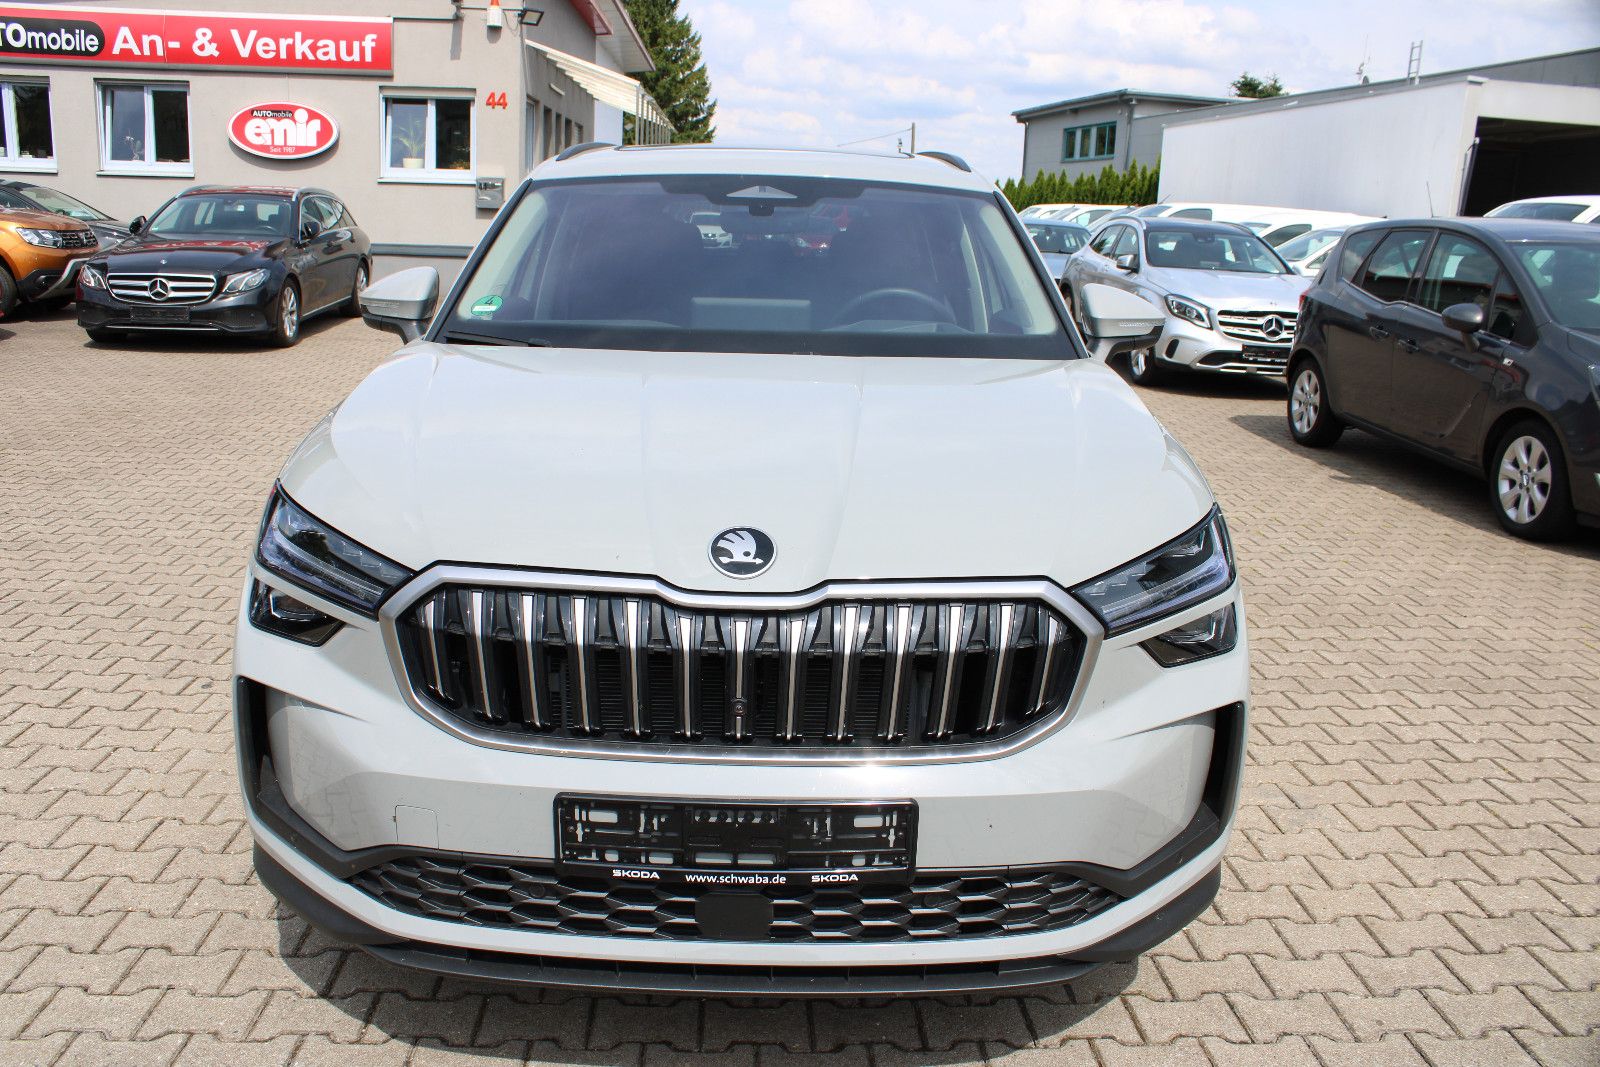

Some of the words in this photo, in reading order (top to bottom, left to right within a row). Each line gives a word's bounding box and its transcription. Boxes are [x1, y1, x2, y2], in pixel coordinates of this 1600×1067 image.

[112, 26, 180, 56] An-
[193, 28, 220, 57] &
[230, 29, 377, 63] Verkauf
[486, 92, 507, 109] 44
[253, 110, 292, 118] AUTOmobile
[244, 108, 321, 147] emir
[685, 874, 786, 884] www.schwaba.de
